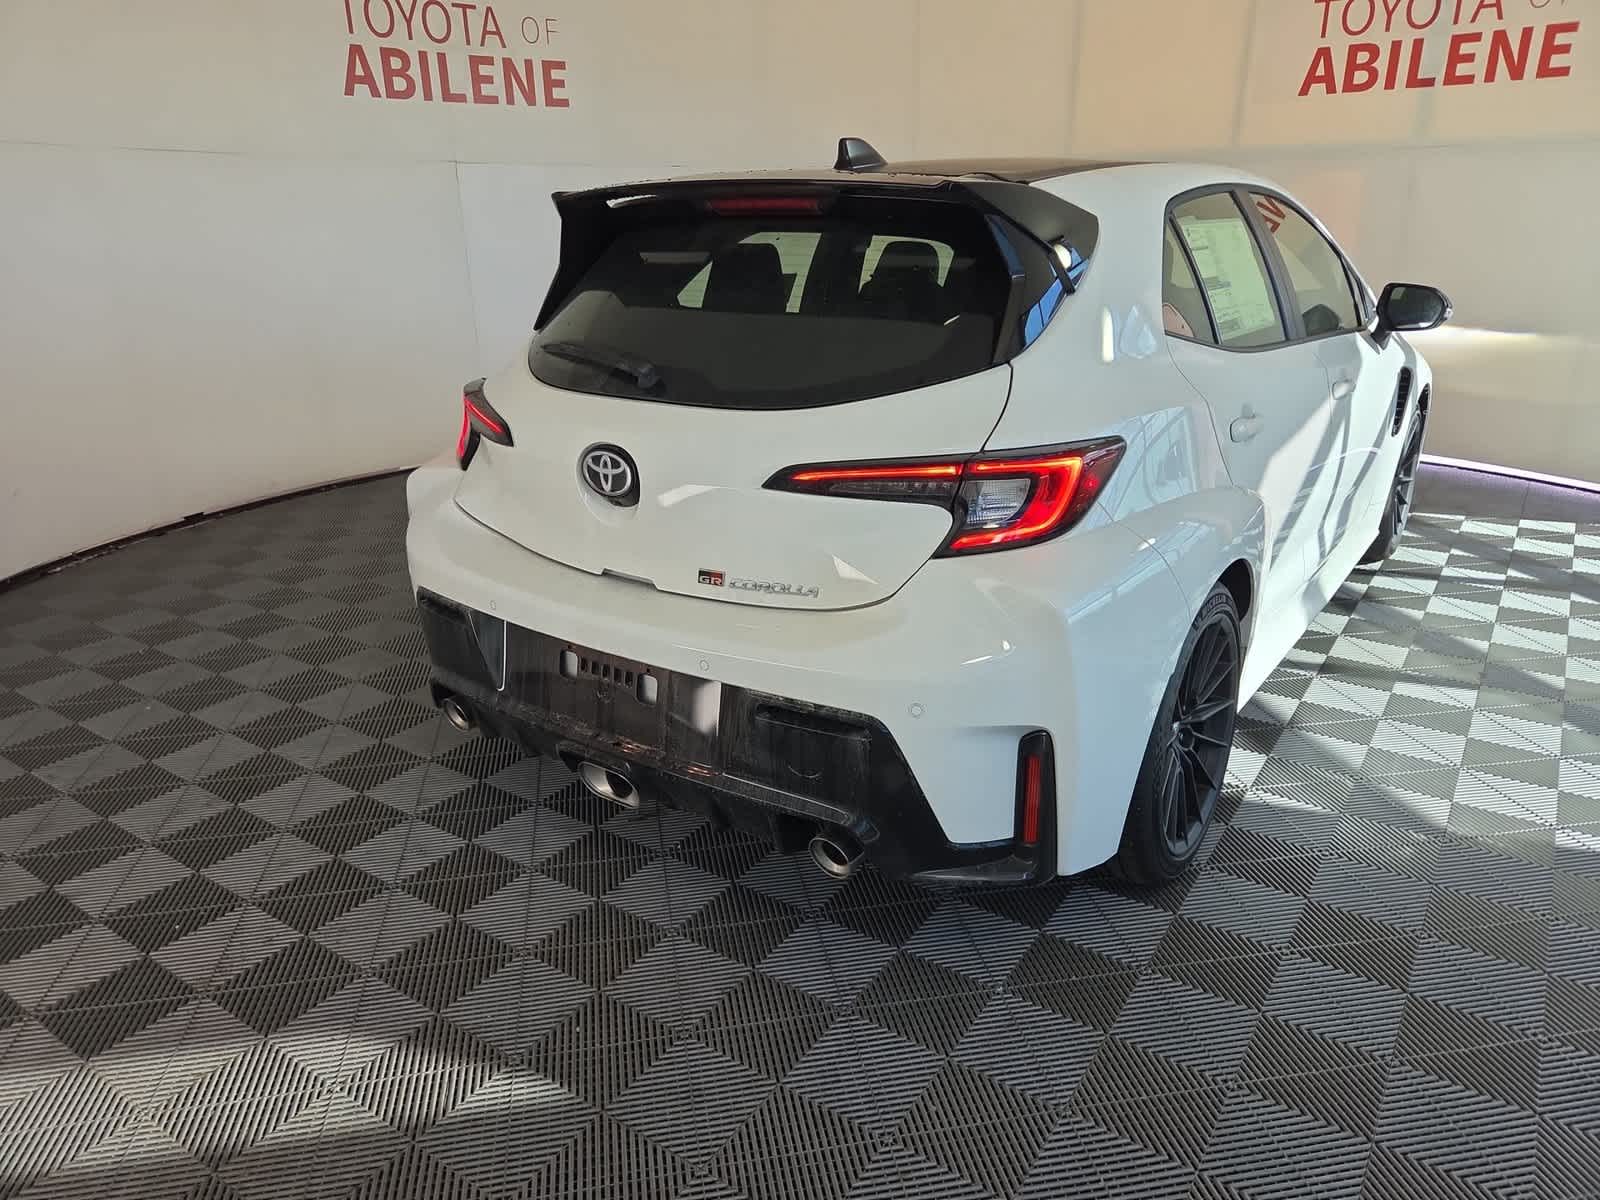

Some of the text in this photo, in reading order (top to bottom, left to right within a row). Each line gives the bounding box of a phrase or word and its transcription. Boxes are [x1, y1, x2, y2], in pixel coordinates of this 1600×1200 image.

[344, 0, 560, 49] TOYOTA OF
[344, 43, 570, 108] ABILENE
[1297, 21, 1581, 97] ABILENE
[698, 572, 819, 599] GR COROLLA
